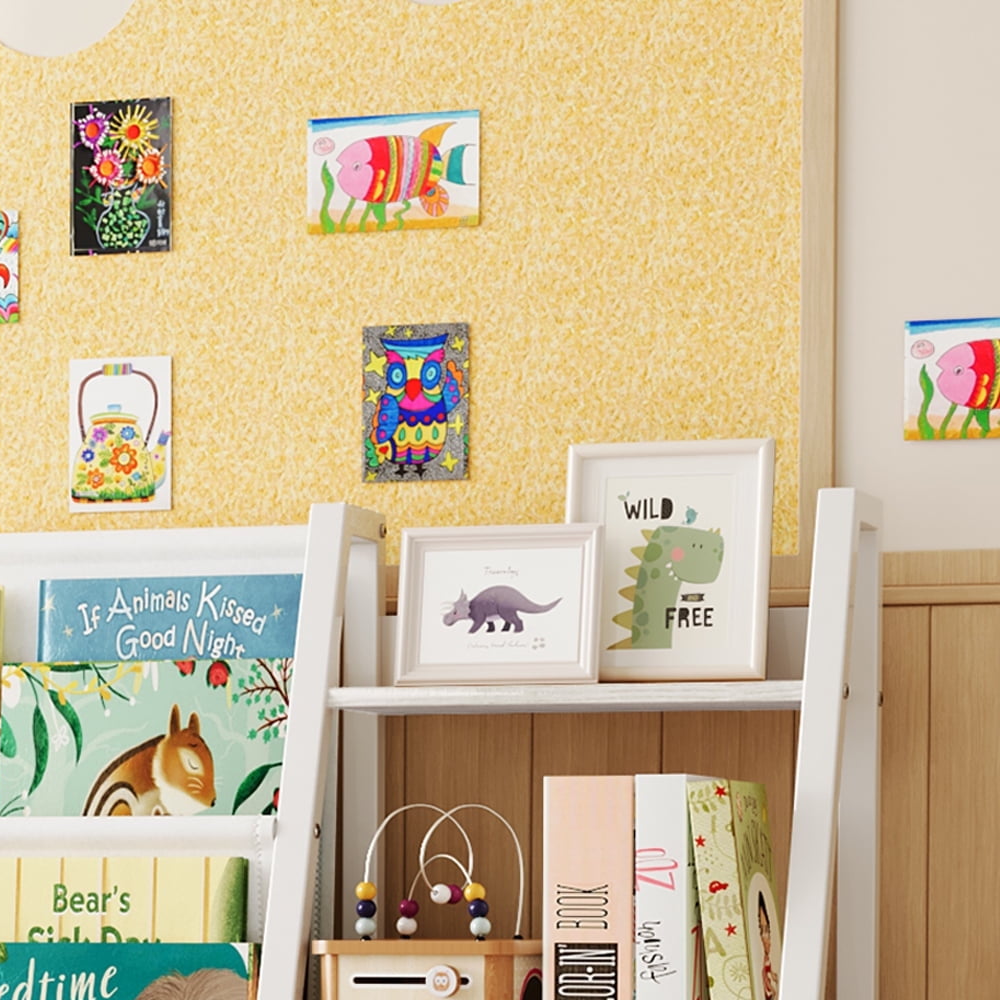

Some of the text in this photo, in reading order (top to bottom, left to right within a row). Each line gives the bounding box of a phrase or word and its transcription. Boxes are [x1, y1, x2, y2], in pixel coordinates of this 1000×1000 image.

[624, 497, 674, 520] WILD
[77, 580, 268, 636] If Animals Kissed
[665, 607, 714, 629] FREE
[115, 618, 246, 661] Good Night
[52, 883, 131, 913] Bear's
[555, 884, 609, 929] BOOK
